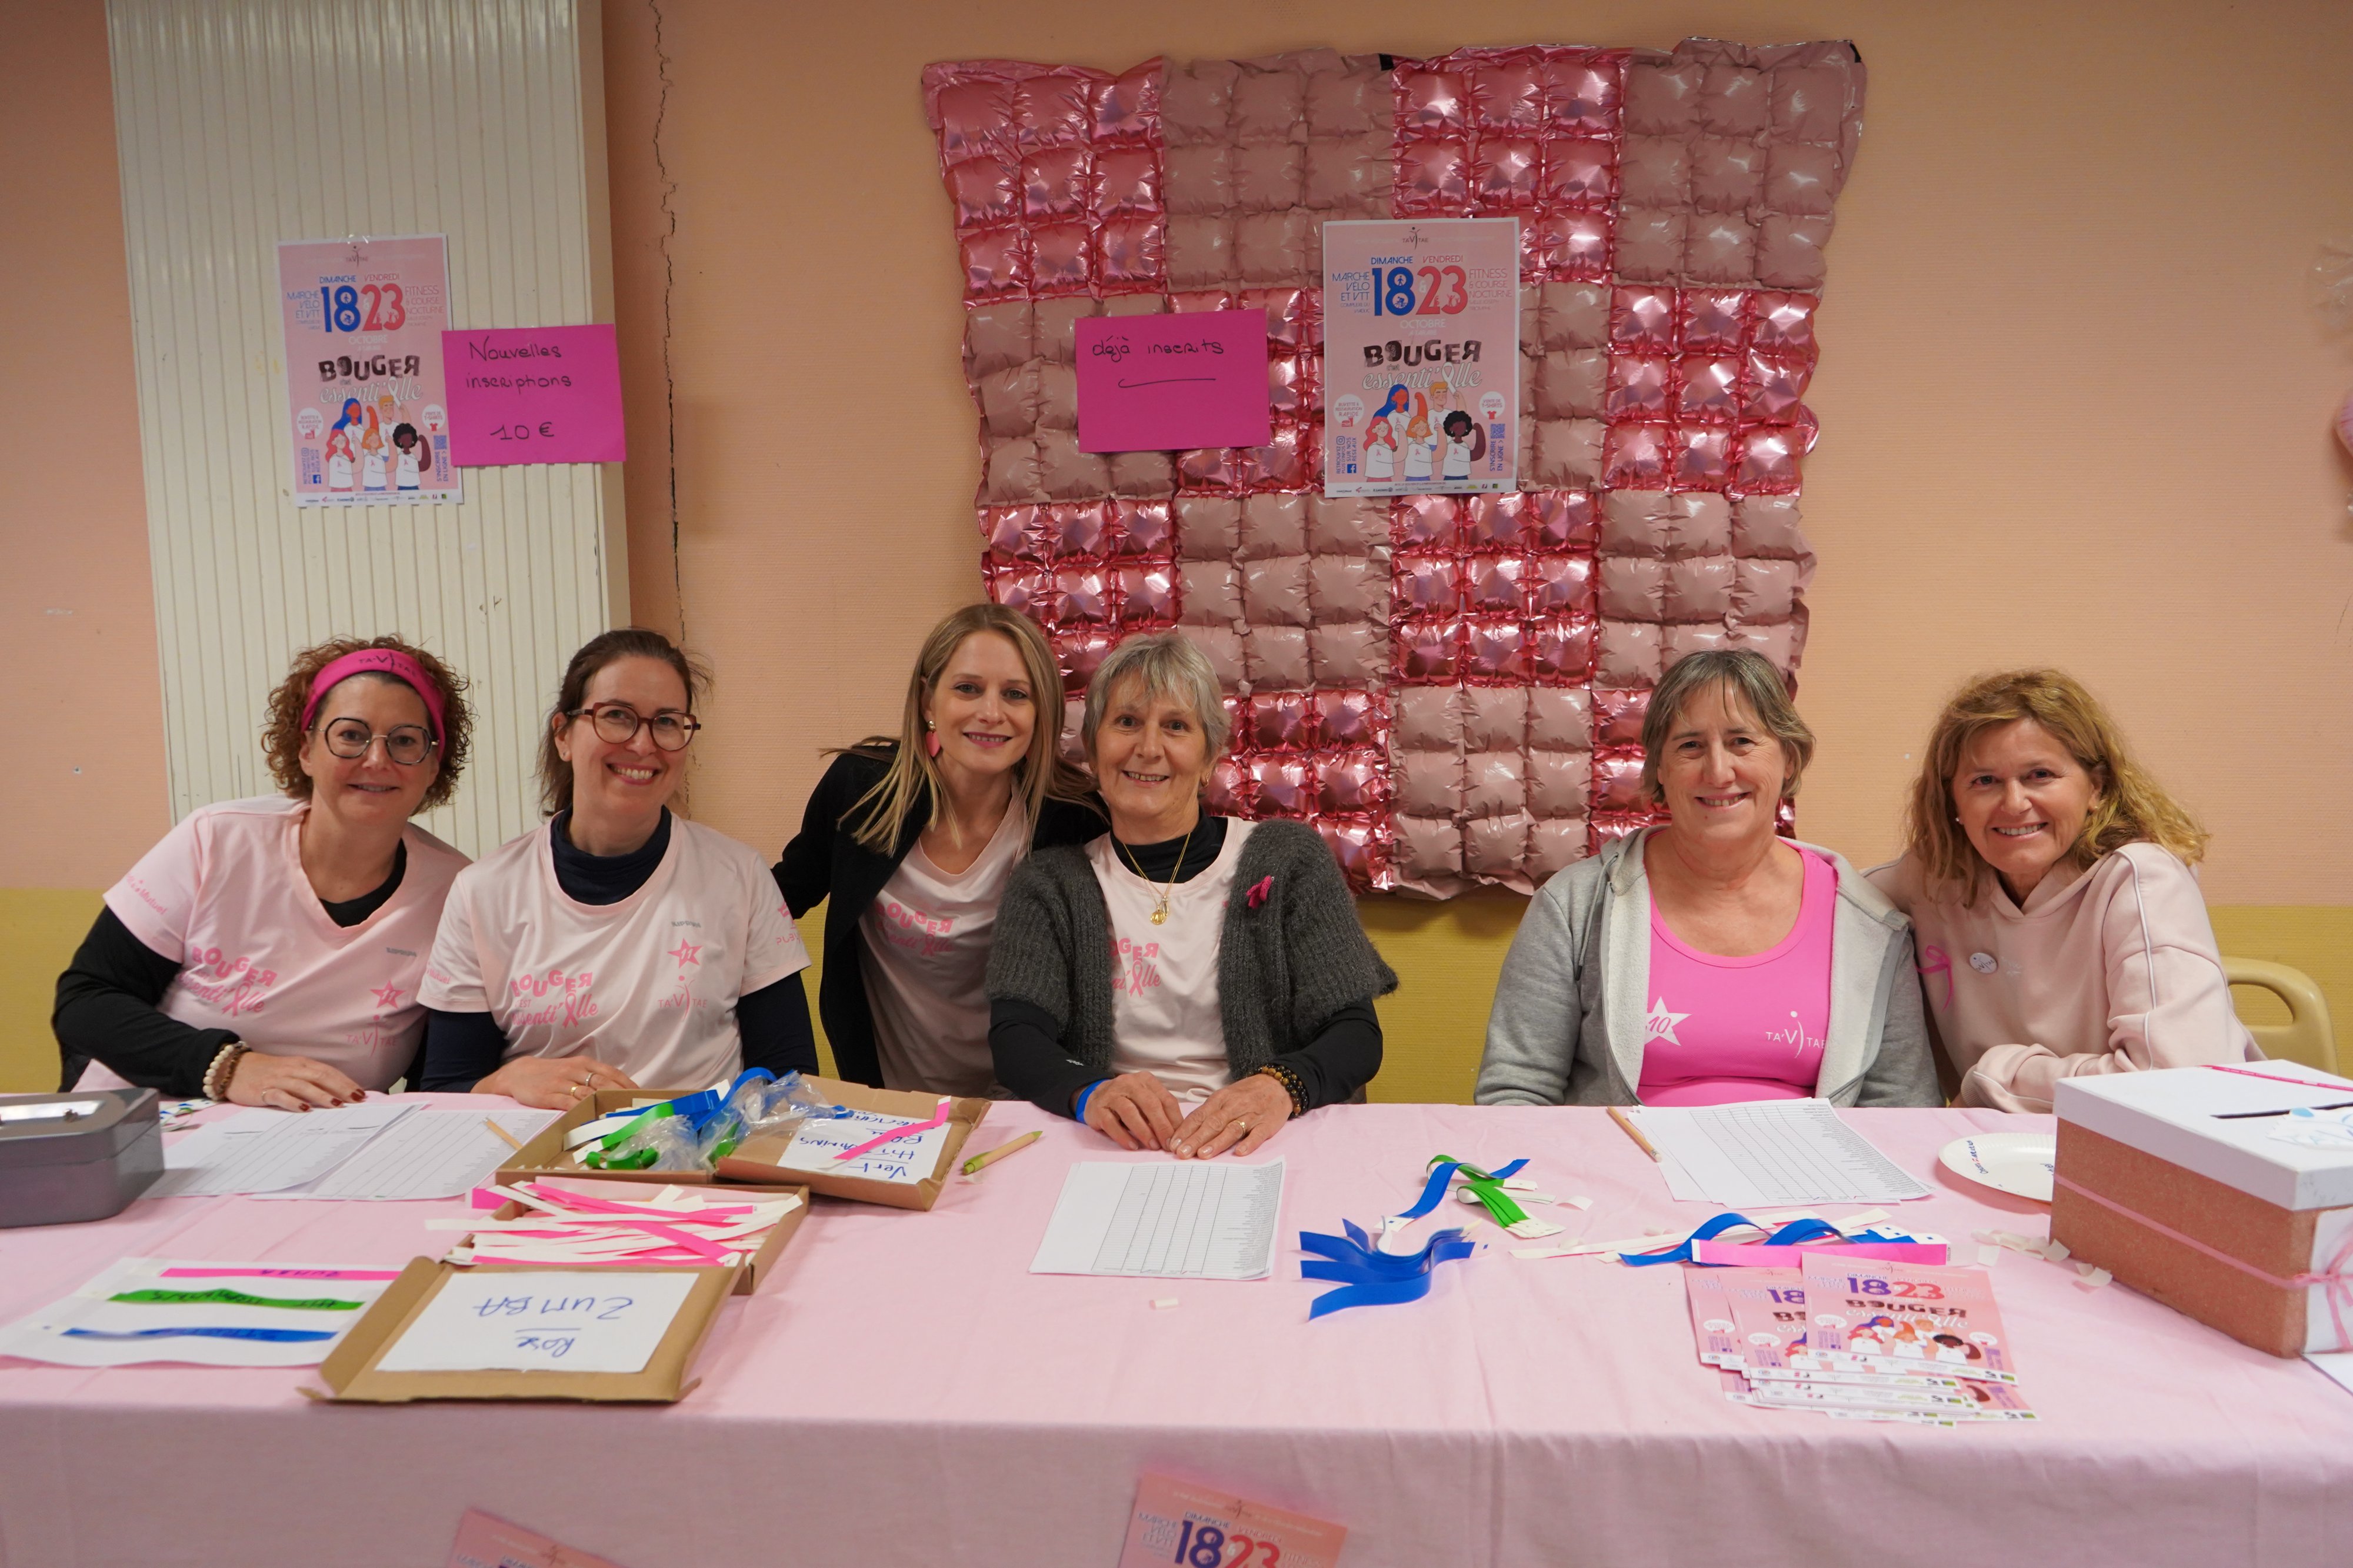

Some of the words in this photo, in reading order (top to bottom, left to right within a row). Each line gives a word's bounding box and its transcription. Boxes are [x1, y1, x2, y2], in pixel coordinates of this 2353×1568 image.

[1371, 256, 1413, 265] DIMANCHE
[1423, 255, 1463, 263] VENDREDI
[319, 275, 356, 284] DIMANCHE
[364, 273, 399, 282] VENDREDI
[1332, 272, 1370, 281] MARCHE
[1469, 268, 1507, 278] FITNESS
[405, 285, 439, 296] FITNESS
[1372, 266, 1415, 316] 18
[1416, 265, 1468, 315] 23
[1475, 280, 1508, 289] COURSE
[1341, 292, 1351, 301] ET
[1354, 292, 1370, 301] VTT
[1469, 290, 1512, 298] NOCTURNE
[321, 285, 361, 332] 18
[361, 283, 406, 331] 23
[1400, 319, 1447, 329] OCTOBRE
[348, 335, 389, 345] OCTOBRE
[1092, 335, 1130, 362] déjà
[469, 336, 562, 362] Nouvelles
[1363, 339, 1482, 368] BOUGER
[318, 355, 420, 382] BOUGER
[490, 424, 529, 440] 10
[539, 422, 555, 437] €
[1648, 1016, 1672, 1034] 10
[1847, 1277, 1892, 1296] 18
[1892, 1281, 1945, 1299] 23
[1767, 1289, 1805, 1305] 18
[1845, 1299, 1967, 1319] BOUGER
[1174, 1520, 1225, 1568] 18
